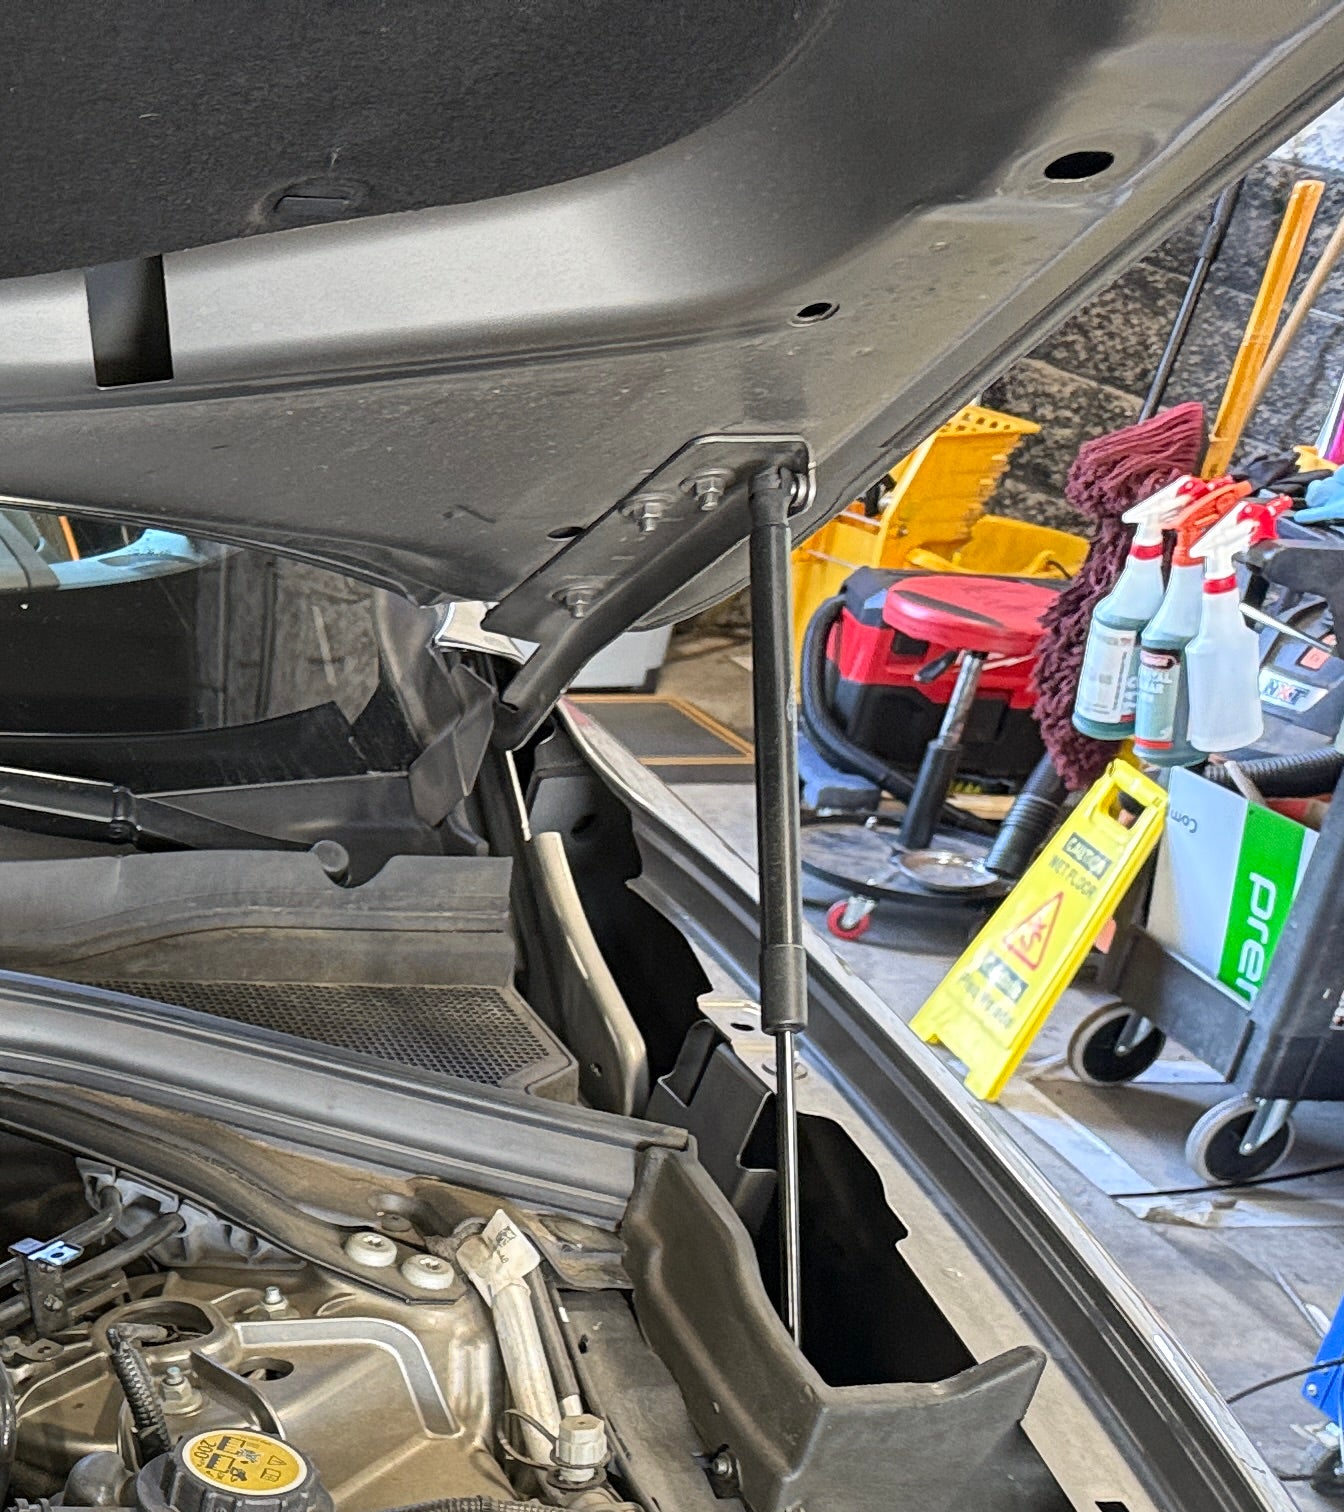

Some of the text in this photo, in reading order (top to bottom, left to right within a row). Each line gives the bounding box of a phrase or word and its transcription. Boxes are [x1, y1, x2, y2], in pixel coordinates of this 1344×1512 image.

[1264, 679, 1310, 706] NXT
[1046, 854, 1098, 899] WET FLOOR
